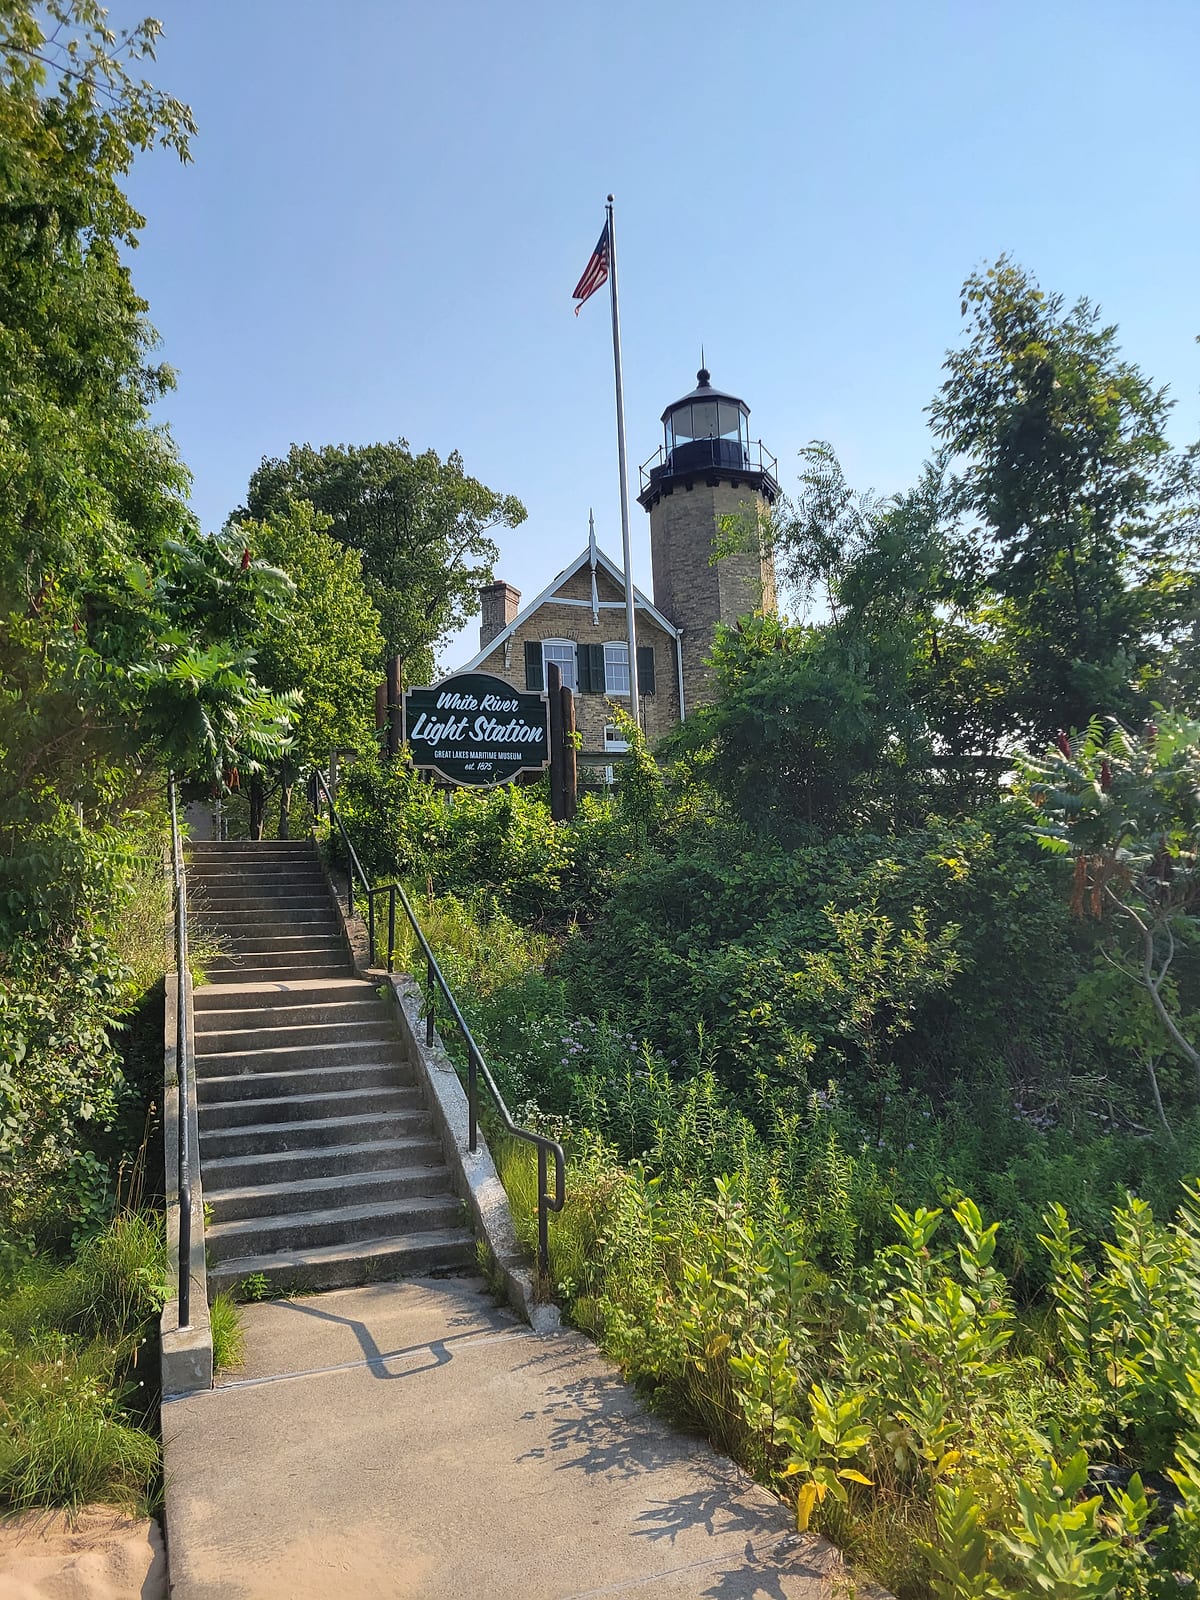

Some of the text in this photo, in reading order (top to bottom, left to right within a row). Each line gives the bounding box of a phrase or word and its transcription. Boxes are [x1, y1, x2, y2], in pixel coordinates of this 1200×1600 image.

[436, 692, 519, 712] White River
[411, 713, 543, 745] Light Station
[434, 750, 522, 760] GREAT LAKES MARITIME MUSEUM
[477, 762, 492, 771] 1875
